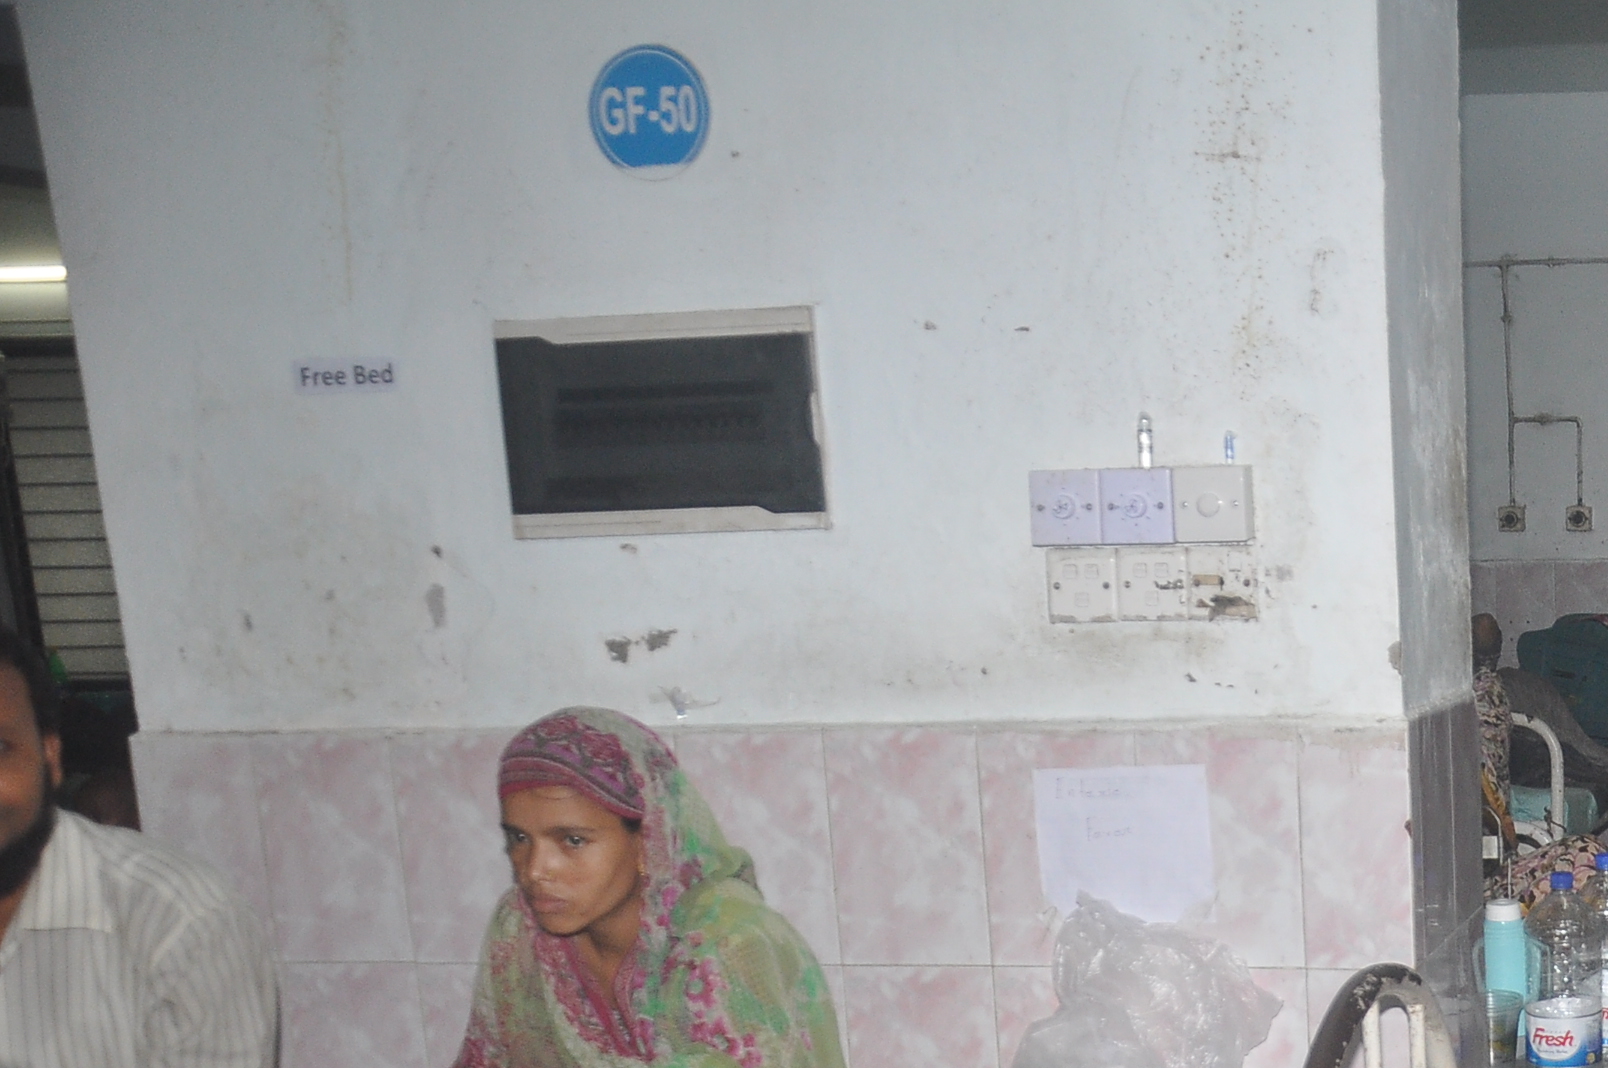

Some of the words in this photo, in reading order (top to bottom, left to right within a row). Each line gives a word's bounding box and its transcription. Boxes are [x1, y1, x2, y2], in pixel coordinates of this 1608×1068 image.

[600, 85, 698, 135] GF-50
[300, 366, 347, 387] Free
[353, 362, 393, 385] Bed
[1532, 1026, 1575, 1046] Fresh
